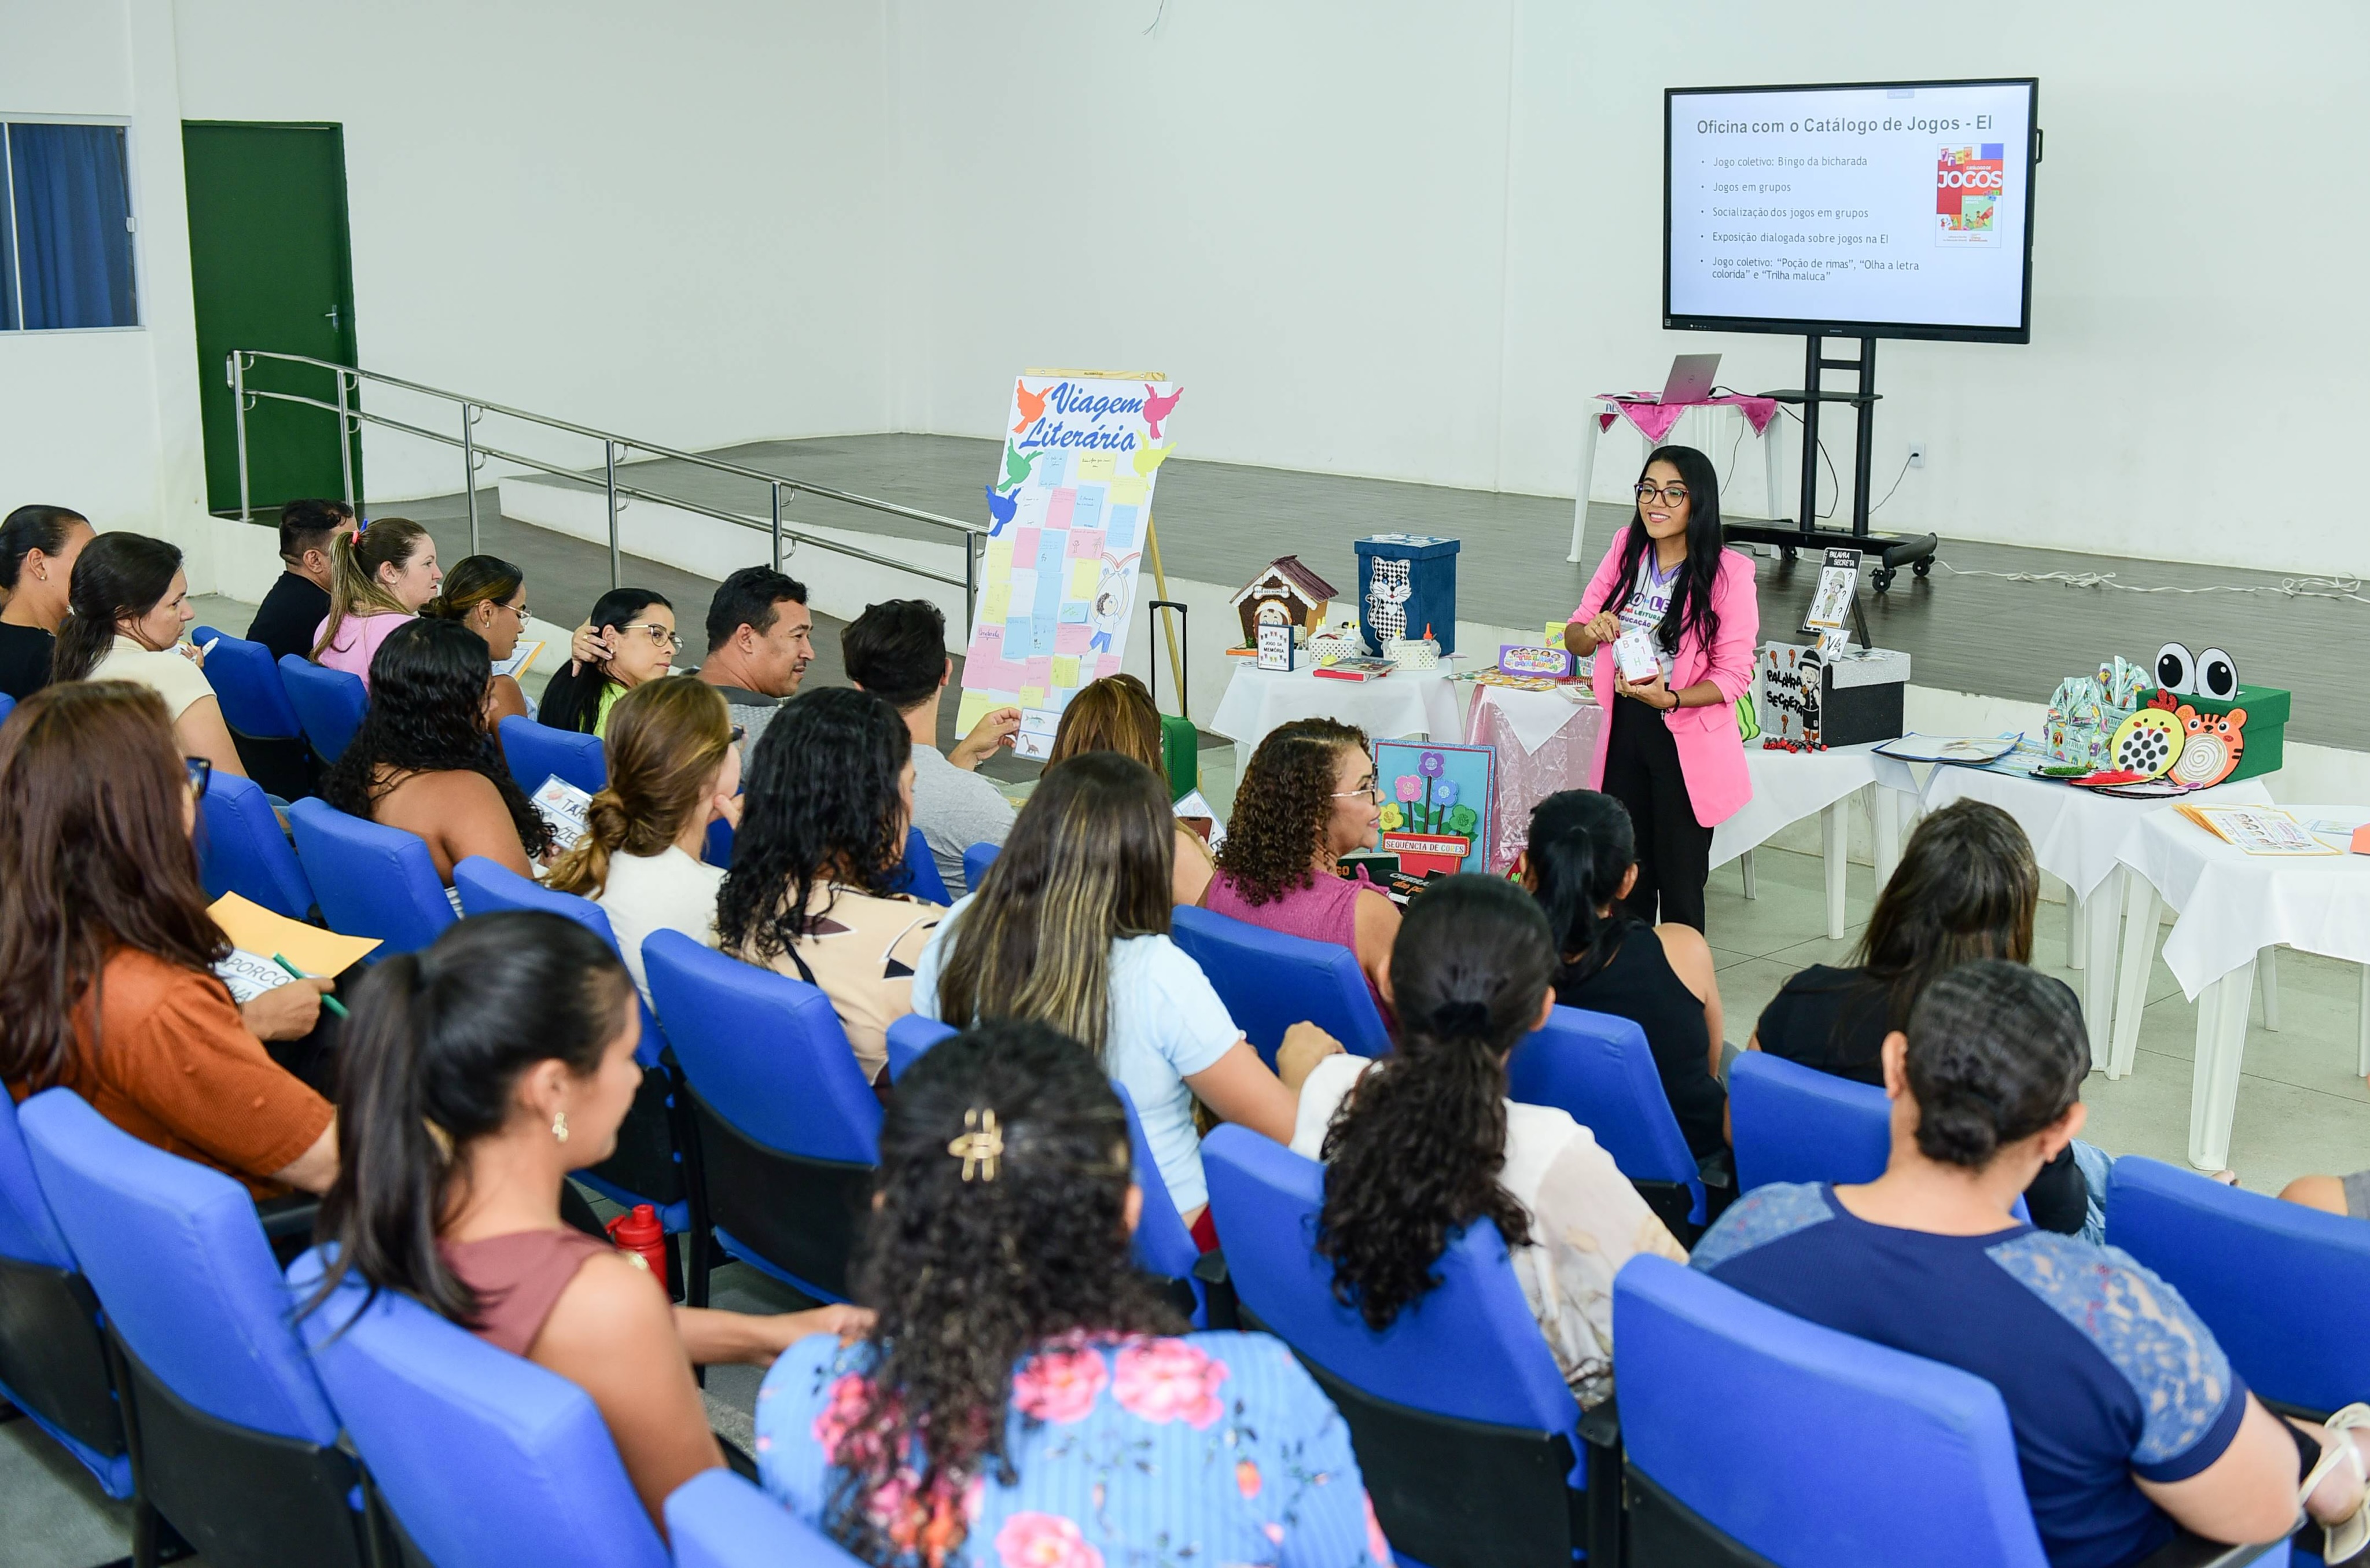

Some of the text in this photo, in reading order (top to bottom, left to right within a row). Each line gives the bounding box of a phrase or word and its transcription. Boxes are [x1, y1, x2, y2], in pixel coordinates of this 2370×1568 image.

[1697, 120, 1747, 134] Oficina
[1751, 122, 1784, 133] com
[1790, 121, 1799, 132] o
[1804, 117, 1878, 135] Catálogo
[1883, 117, 1902, 131] de
[1907, 116, 1960, 134] Jogos
[1713, 156, 1868, 168] Jogo coletivo: Bingo da bicharada
[1937, 170, 2003, 188] JOGOS
[1713, 182, 1791, 194] Jogos em grupos
[1712, 207, 1869, 220] Socialização dos jogos em grupos
[1712, 232, 1757, 245] Exposição
[1760, 232, 1805, 245] dialogada
[1808, 233, 1835, 244] sobre
[1837, 234, 1863, 245] jogos
[1865, 235, 1877, 244] na
[1712, 257, 1734, 269] Jogo
[1736, 257, 1773, 267] coletivo:
[1776, 257, 1809, 270] “Poção
[1810, 258, 1823, 268] de
[1859, 259, 1885, 270] “Olha
[1896, 260, 1919, 270] letra
[1753, 271, 1759, 279] e
[1051, 381, 1144, 423] Viagem
[1018, 417, 1136, 452] Literária
[1829, 551, 1850, 559] PALAVRA
[1833, 558, 1854, 567] SECRETA
[1617, 614, 1651, 628] EDUCAÇÃO
[1634, 609, 1661, 621] LEITURA
[1767, 669, 1802, 690] PALAVRA
[1766, 690, 1803, 717] SECRETA
[1385, 839, 1464, 853] SEQUÊNCIA DE CORES
[1336, 865, 1350, 876] GO
[223, 957, 291, 987] PORCO
